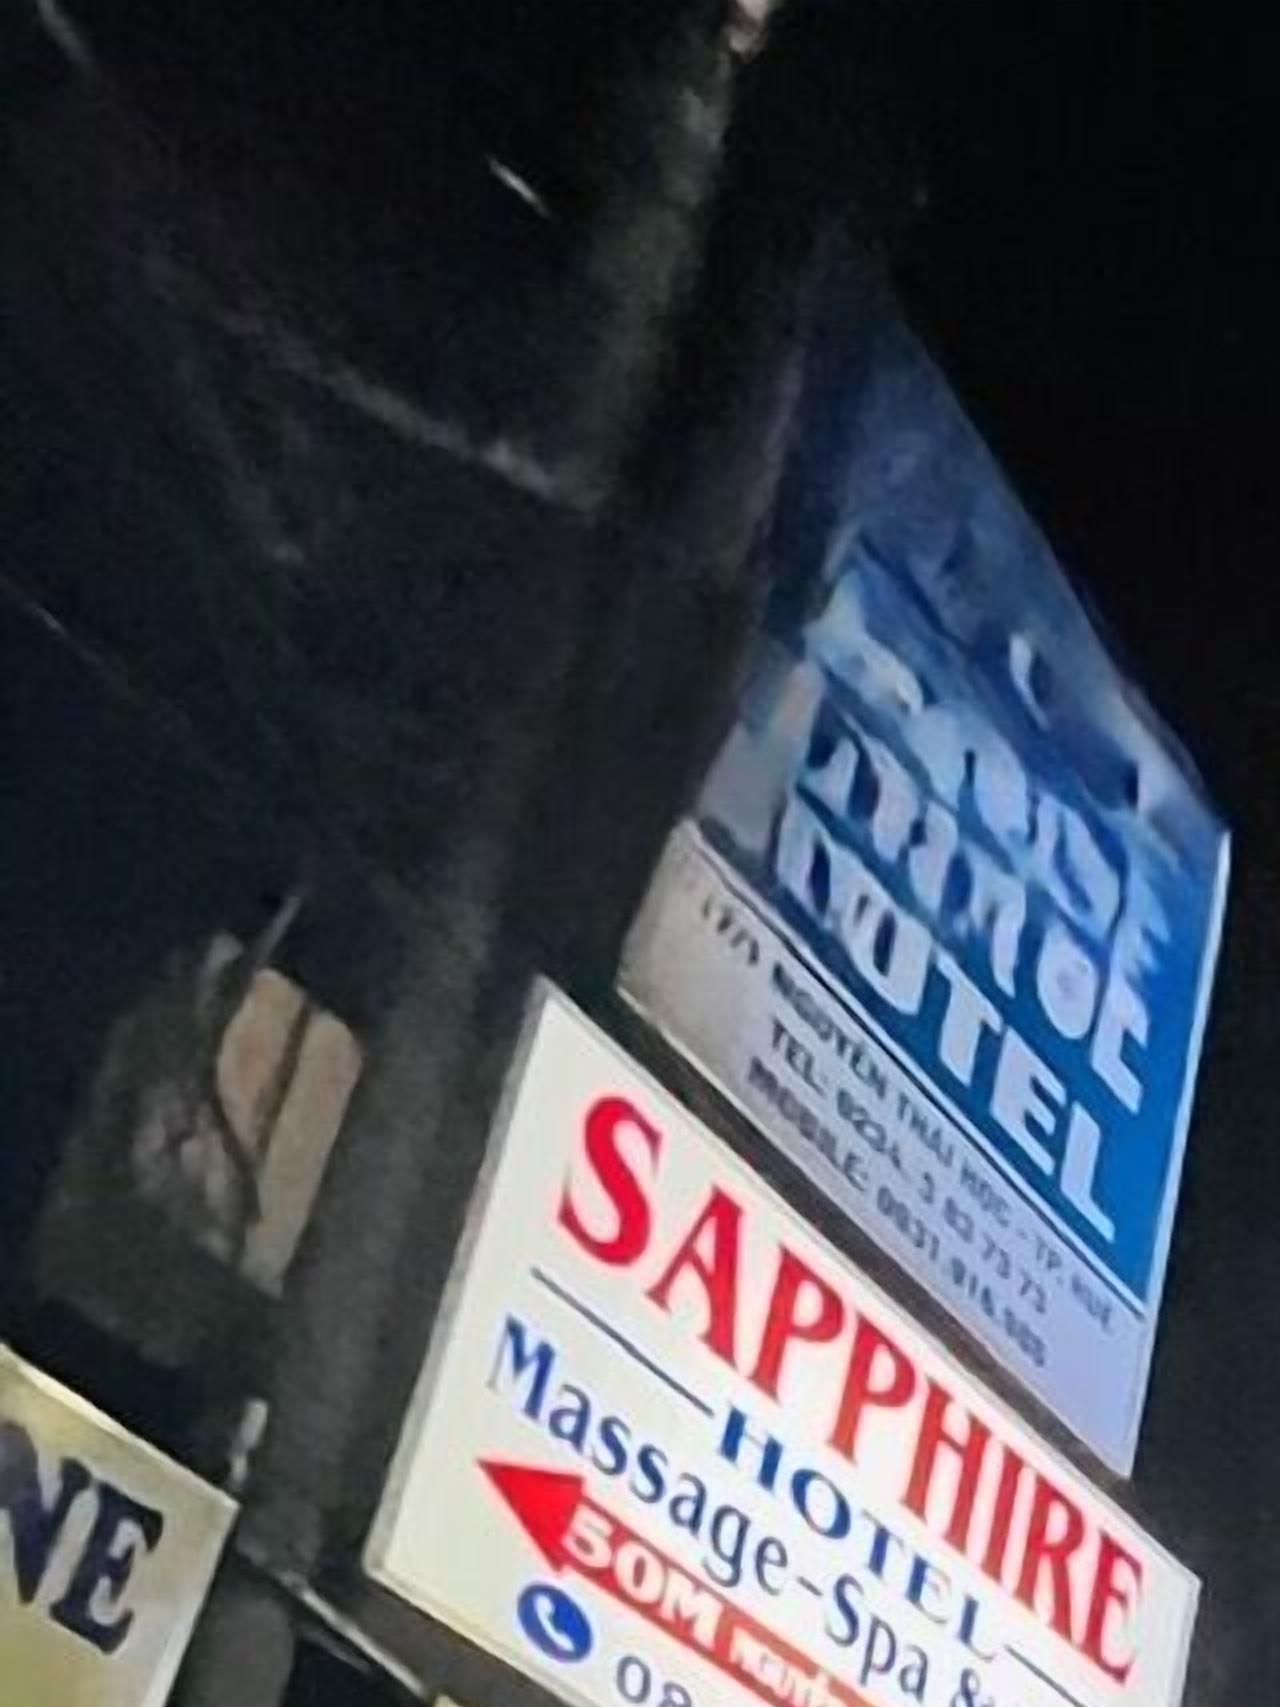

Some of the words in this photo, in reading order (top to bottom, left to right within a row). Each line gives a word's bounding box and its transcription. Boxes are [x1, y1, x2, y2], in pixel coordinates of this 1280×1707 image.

[555, 1093, 1145, 1689] SAPPHIRE
[562, 1506, 722, 1651] 50M
[717, 1406, 1002, 1660] HOTEL
